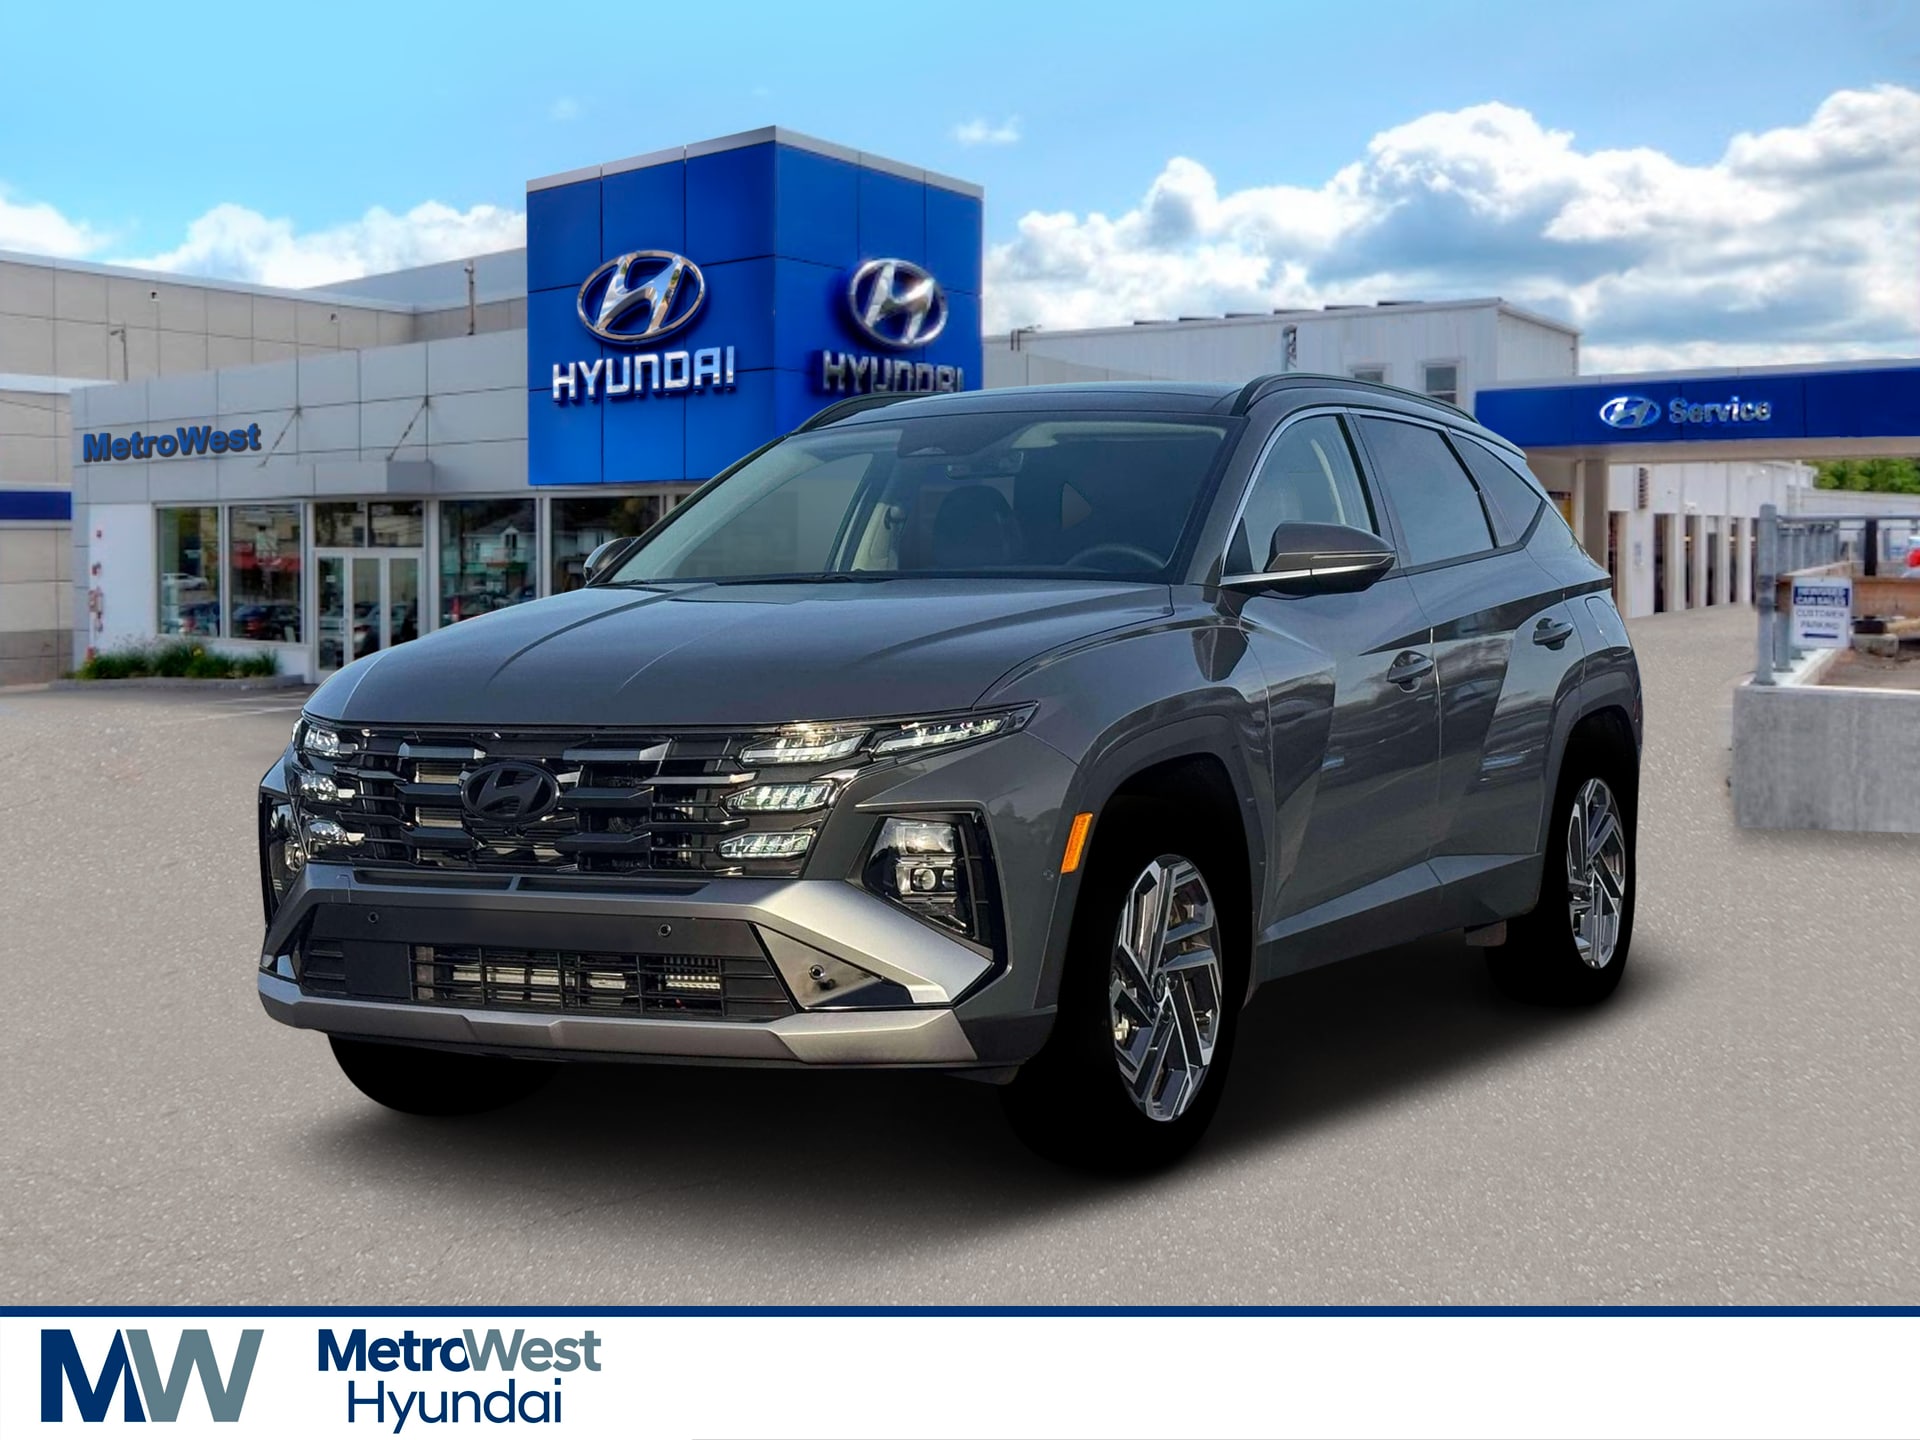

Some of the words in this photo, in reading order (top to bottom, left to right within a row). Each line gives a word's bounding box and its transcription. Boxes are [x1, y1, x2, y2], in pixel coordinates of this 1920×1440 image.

[553, 346, 735, 399] HYUNDAI
[823, 350, 965, 393] HYUNDAI
[1669, 395, 1771, 423] Service
[83, 423, 262, 463] MetroWest
[1796, 608, 1845, 619] CUSTOMER
[1800, 620, 1840, 630] PARKING
